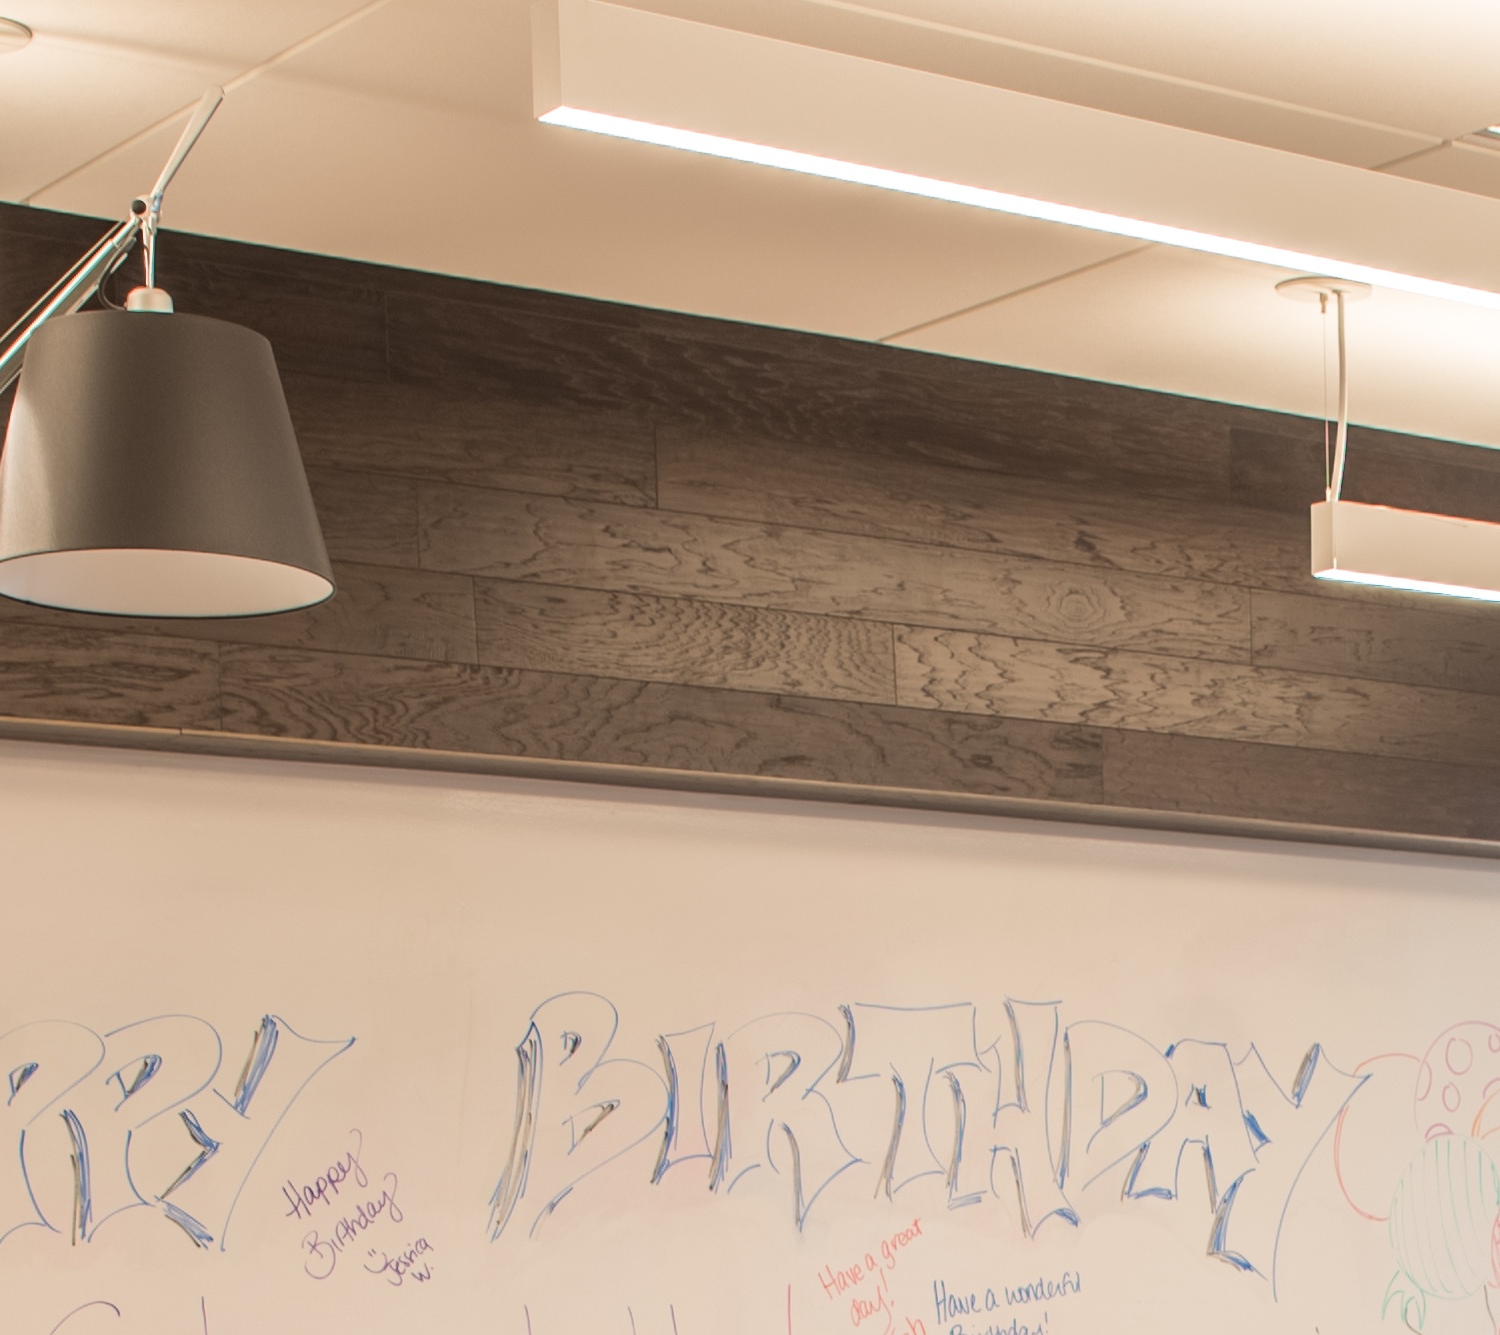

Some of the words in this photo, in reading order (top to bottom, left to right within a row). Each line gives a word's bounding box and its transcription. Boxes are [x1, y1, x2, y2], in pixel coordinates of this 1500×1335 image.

[282, 1128, 368, 1219] Happy
[488, 991, 1373, 1301] BIRTHDAY
[818, 1265, 865, 1300] Have
[865, 1253, 877, 1272] a
[881, 1218, 923, 1269] great
[933, 1280, 981, 1324] Have
[985, 1289, 999, 1311] a
[1005, 1272, 1081, 1306] wonderful
